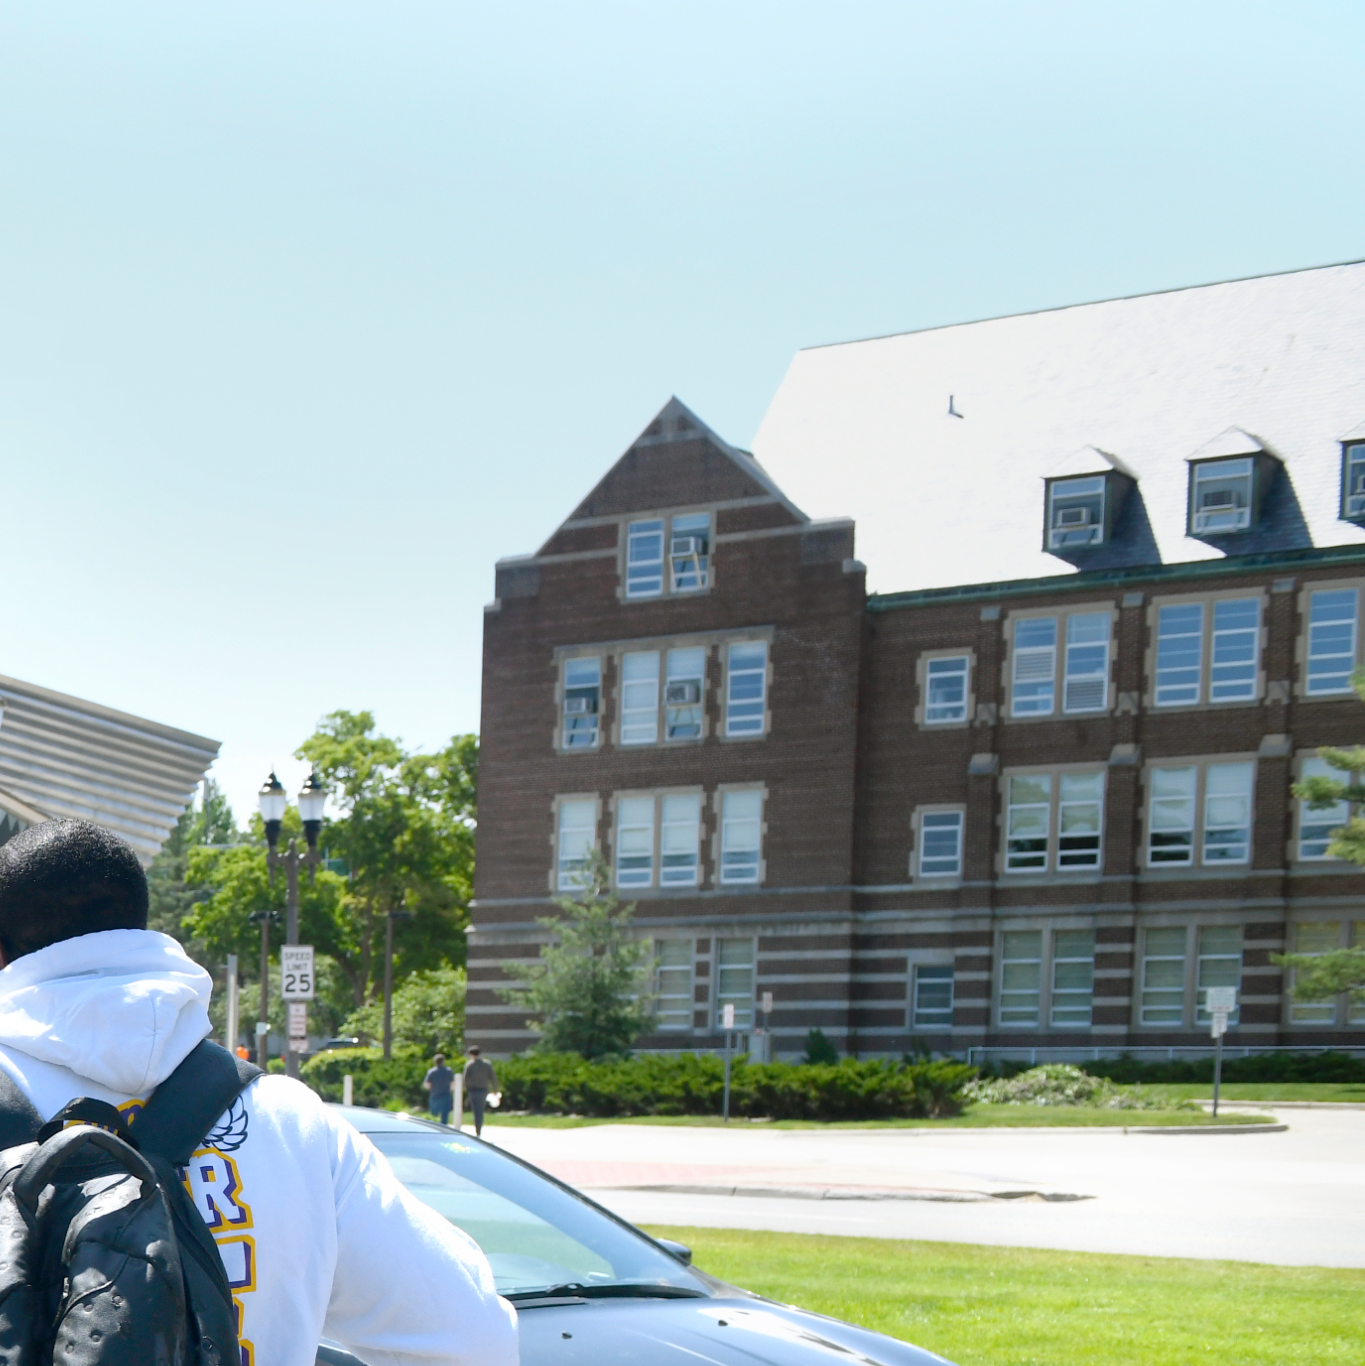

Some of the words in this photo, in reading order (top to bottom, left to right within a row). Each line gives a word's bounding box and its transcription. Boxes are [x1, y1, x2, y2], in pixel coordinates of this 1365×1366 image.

[284, 951, 312, 961] SPEED
[286, 963, 308, 971] LIMIT
[285, 974, 311, 992] 25
